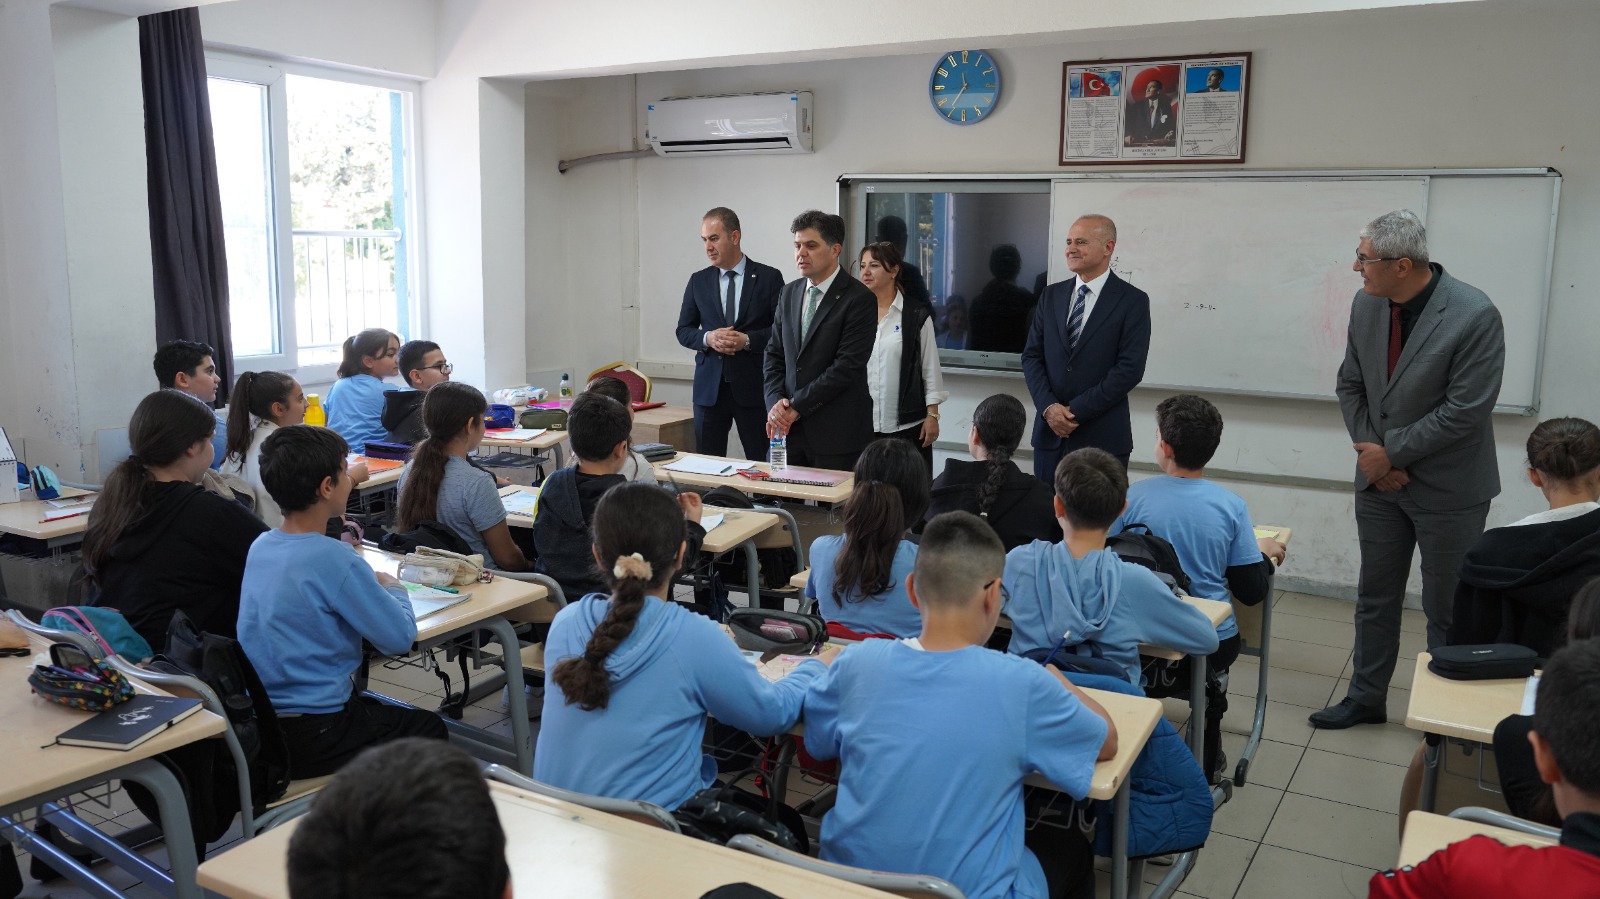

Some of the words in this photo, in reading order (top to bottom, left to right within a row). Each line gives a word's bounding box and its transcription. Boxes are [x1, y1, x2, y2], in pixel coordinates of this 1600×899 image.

[962, 50, 968, 64] 12
[975, 54, 982, 67] 1
[982, 66, 994, 76] 2
[948, 106, 956, 118] 7
